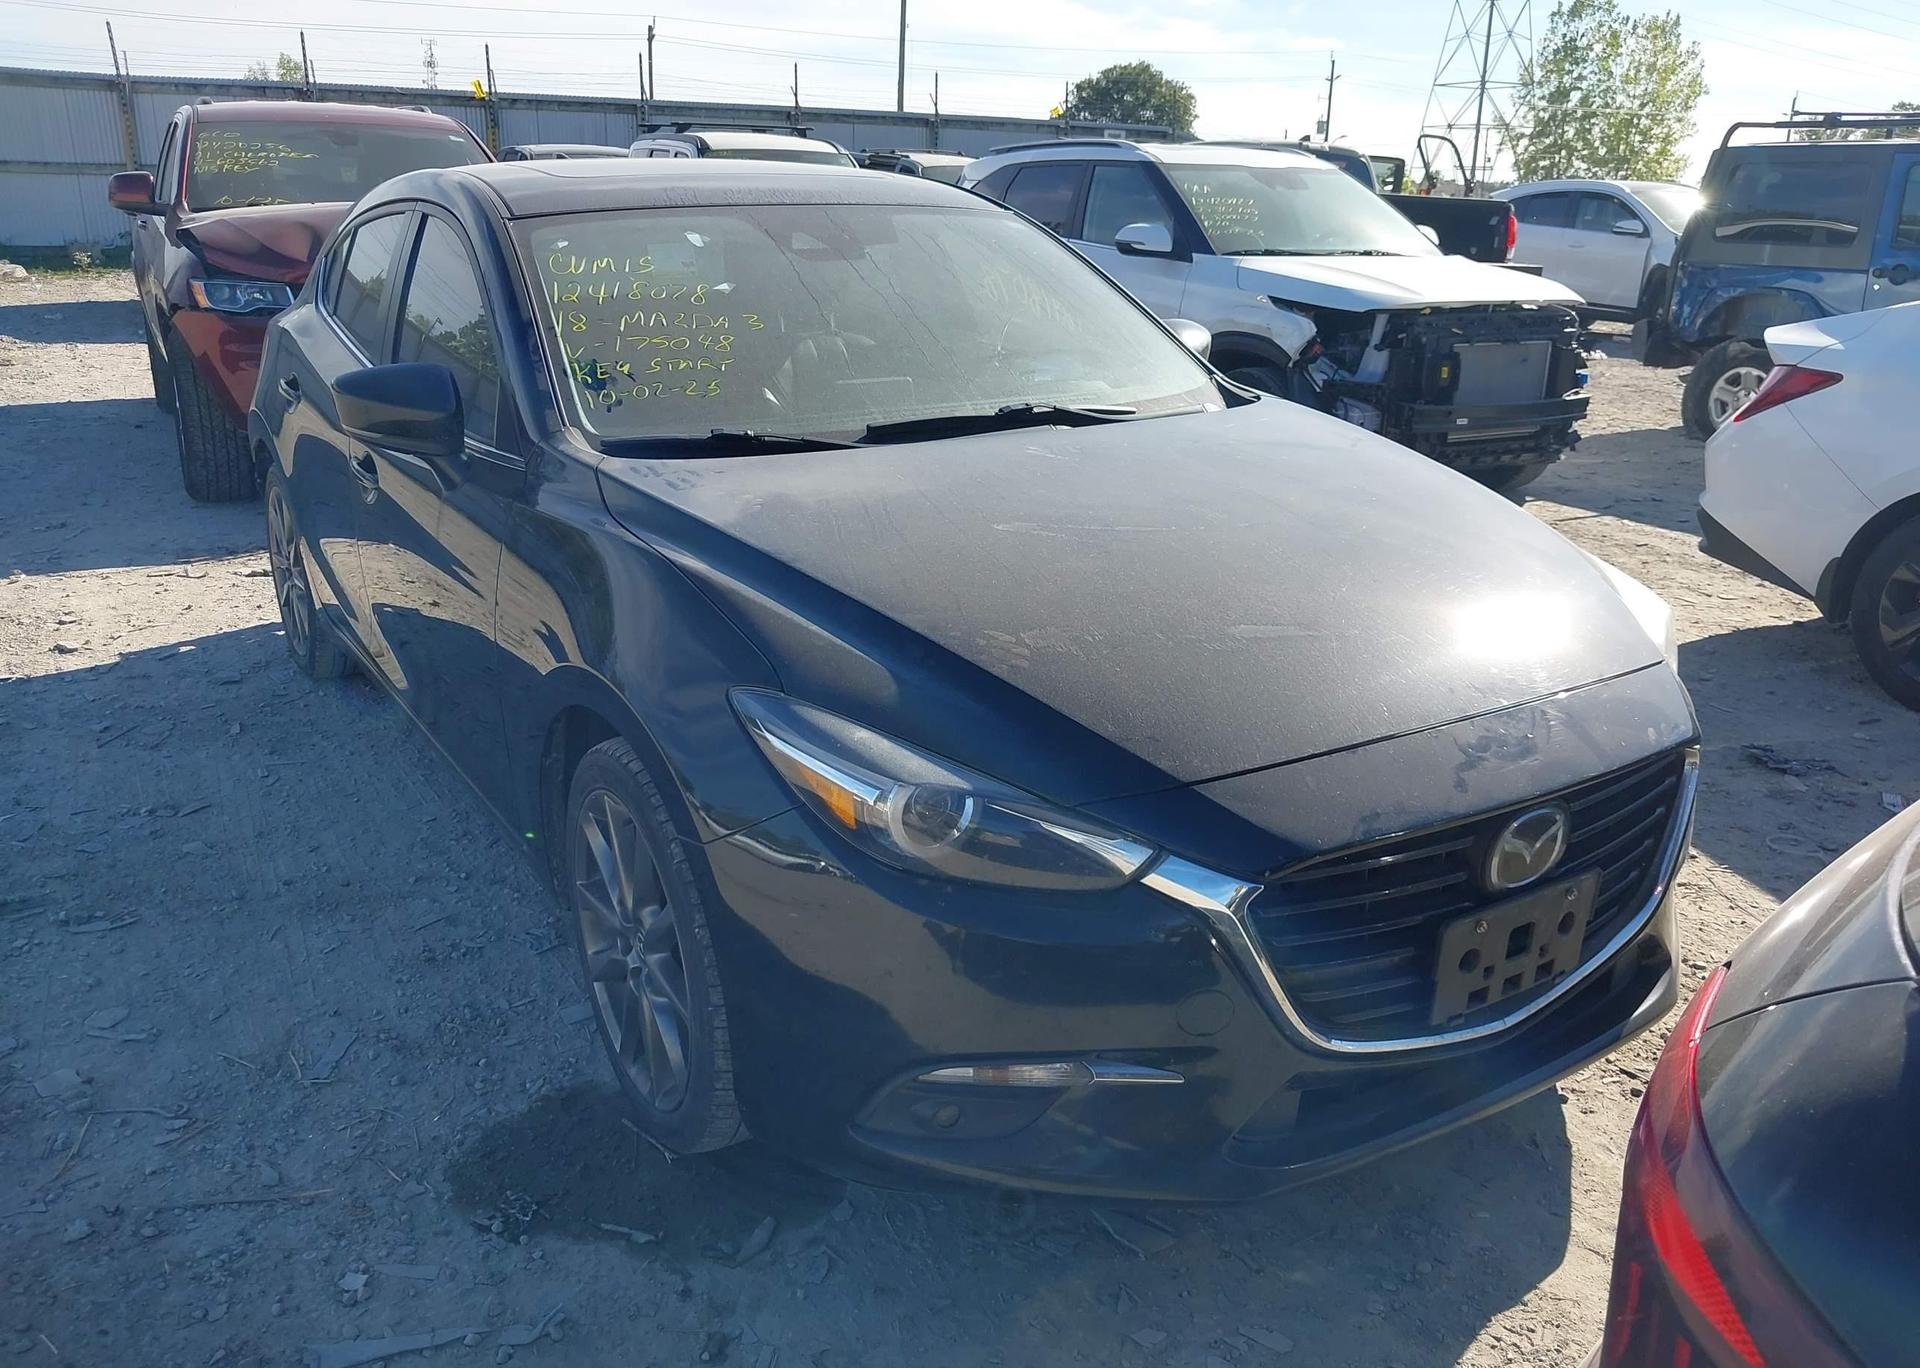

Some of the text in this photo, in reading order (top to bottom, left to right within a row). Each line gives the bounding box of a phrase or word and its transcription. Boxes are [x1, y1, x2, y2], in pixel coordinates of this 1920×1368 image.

[548, 253, 656, 275] CUMIS
[551, 280, 712, 305] 12418078
[740, 313, 765, 331] 3
[645, 357, 737, 374] START
